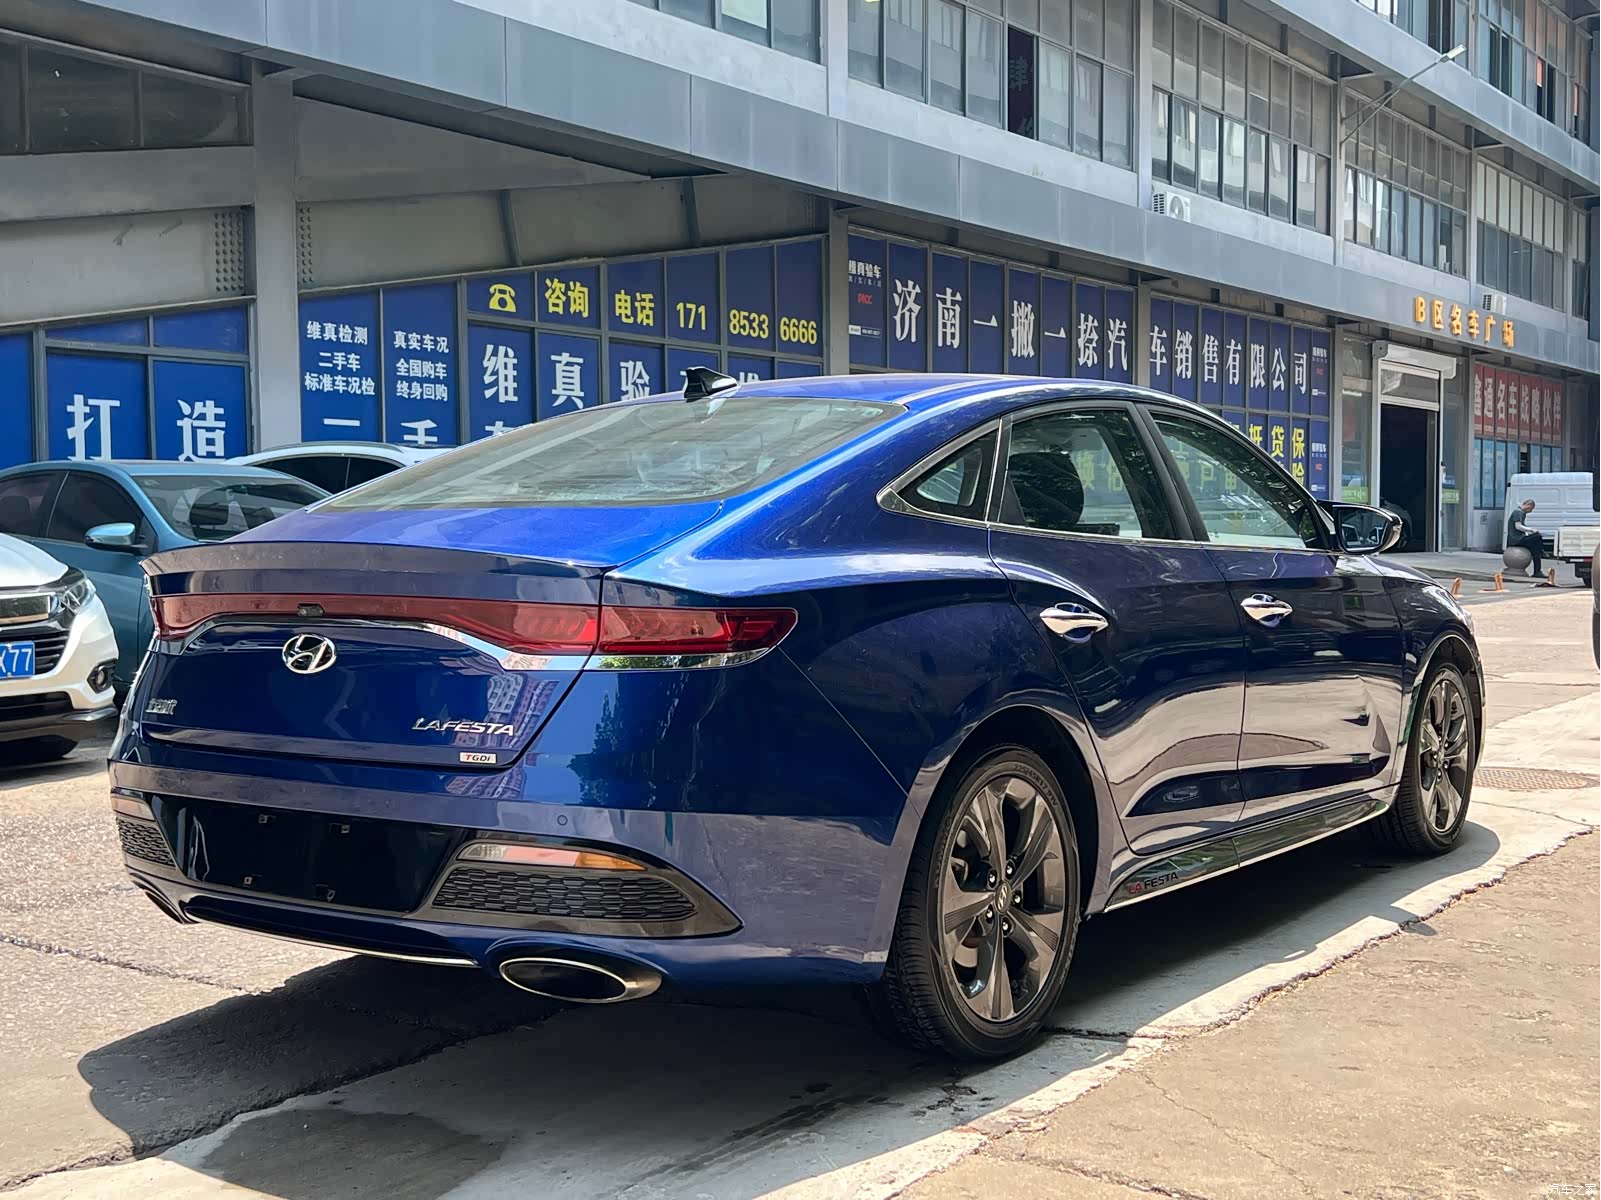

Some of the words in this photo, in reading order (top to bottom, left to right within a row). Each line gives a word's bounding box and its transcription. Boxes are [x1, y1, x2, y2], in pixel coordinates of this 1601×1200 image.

[545, 278, 589, 318] 咨询
[614, 289, 655, 327] 电话
[676, 303, 707, 330] 171
[729, 310, 769, 340] 8533
[780, 317, 817, 345] 6666
[307, 321, 368, 345] 维真检测
[393, 331, 449, 353] 真实车况
[319, 352, 361, 372] 二手车
[396, 358, 447, 380] 全国购车
[305, 372, 375, 395] 标准车况检
[396, 380, 448, 401] 终身回购
[412, 718, 514, 736] LAFESTA
[1144, 871, 1178, 889] FESTA
